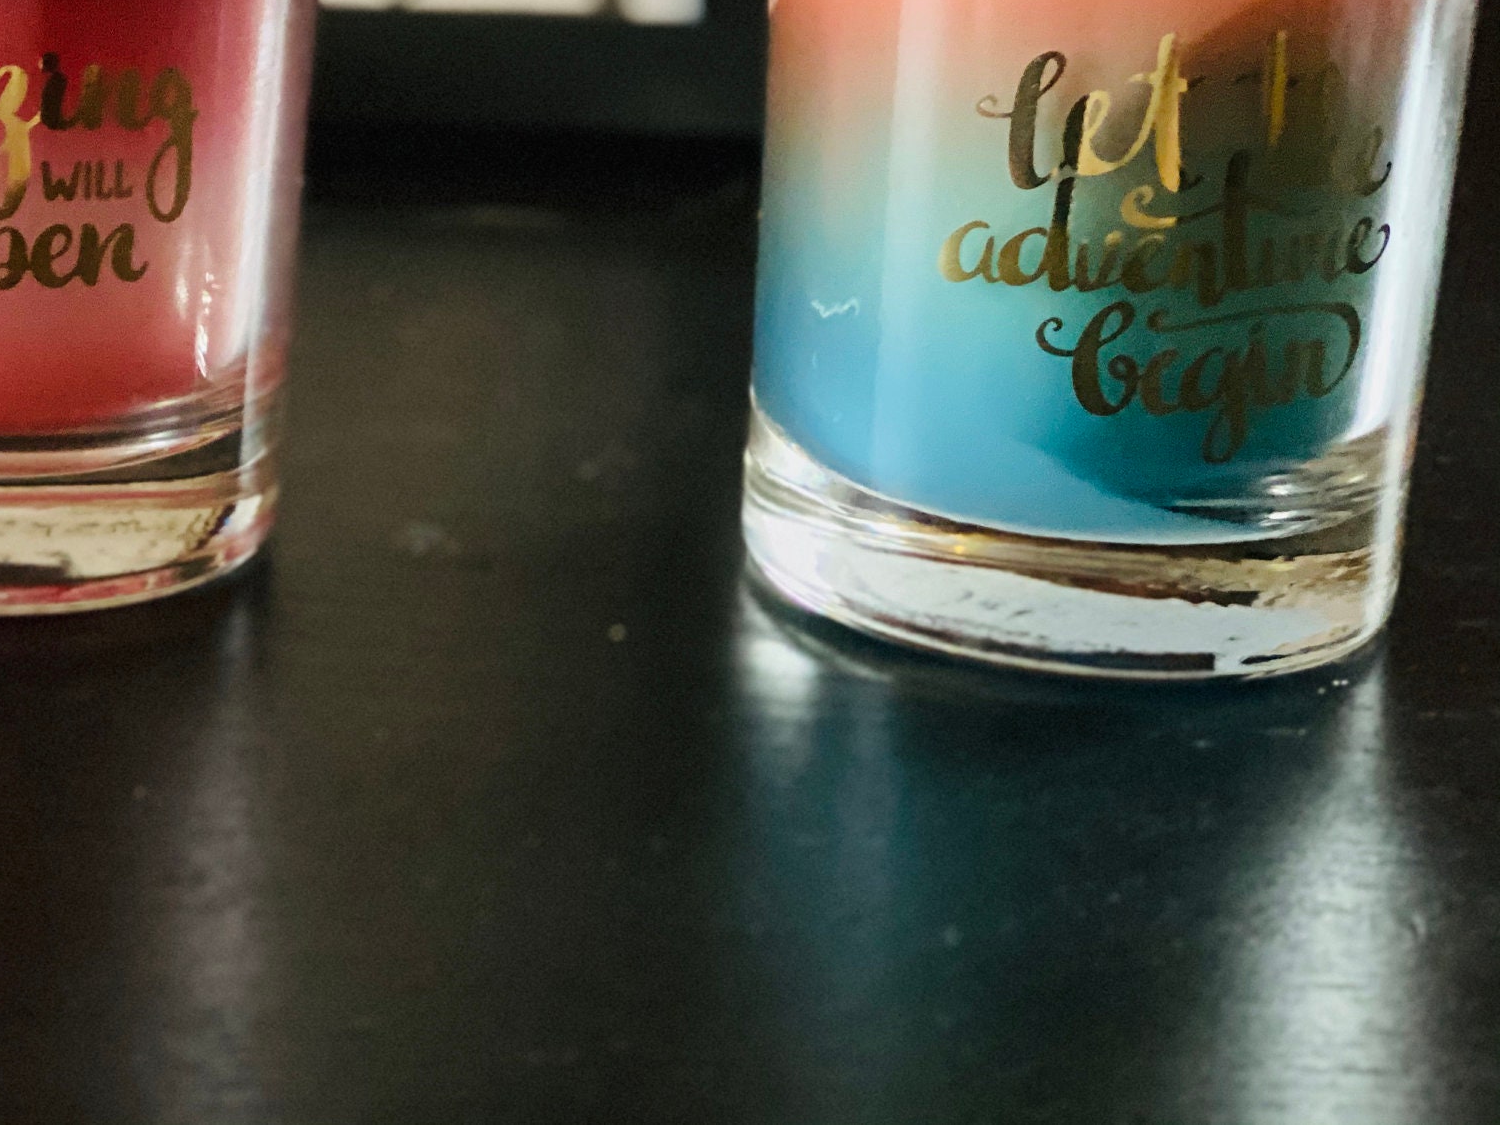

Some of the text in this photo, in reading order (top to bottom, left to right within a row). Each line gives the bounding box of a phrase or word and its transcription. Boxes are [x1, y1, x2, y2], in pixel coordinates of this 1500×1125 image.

[41, 160, 134, 201] WILL
[939, 148, 1392, 307] adventure
[1035, 301, 1361, 465] begin
